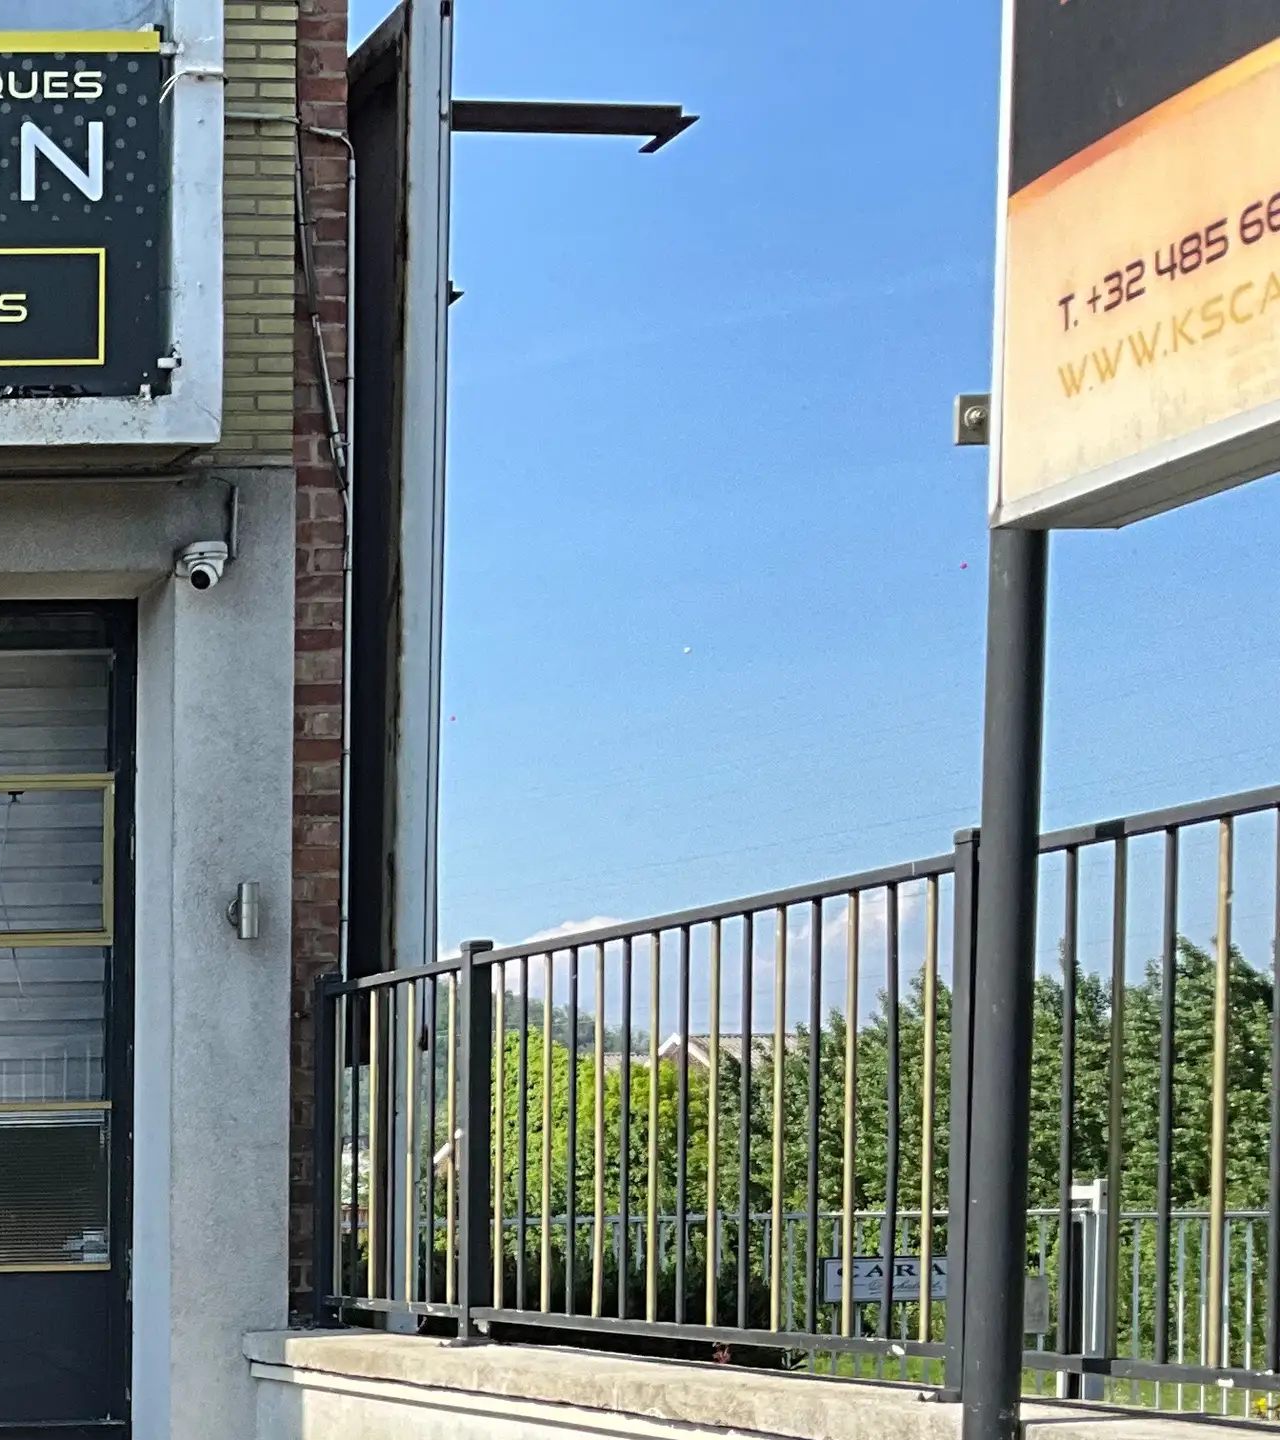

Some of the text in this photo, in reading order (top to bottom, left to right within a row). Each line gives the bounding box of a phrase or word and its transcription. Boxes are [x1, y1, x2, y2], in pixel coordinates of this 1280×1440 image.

[1058, 293, 1078, 332] T.
[1086, 259, 1146, 313] +32
[1155, 217, 1229, 281] 485
